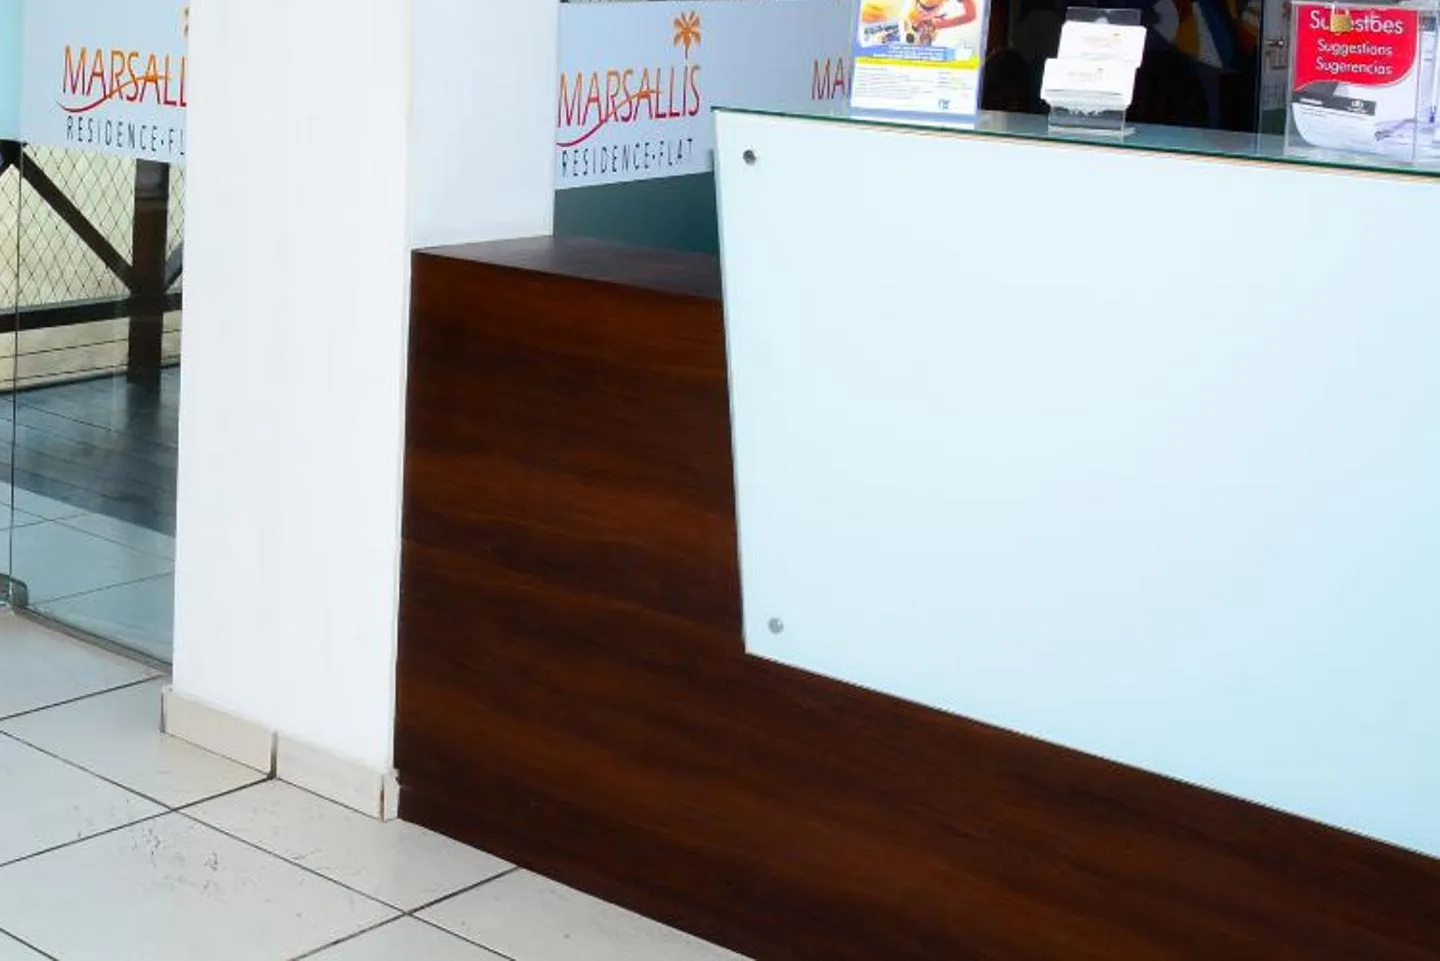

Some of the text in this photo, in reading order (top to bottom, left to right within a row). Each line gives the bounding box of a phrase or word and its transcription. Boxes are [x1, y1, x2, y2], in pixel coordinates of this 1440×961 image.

[1317, 38, 1394, 58] Suggestions
[1315, 56, 1393, 75] Sugerencias
[557, 62, 702, 131] MARSALLIS
